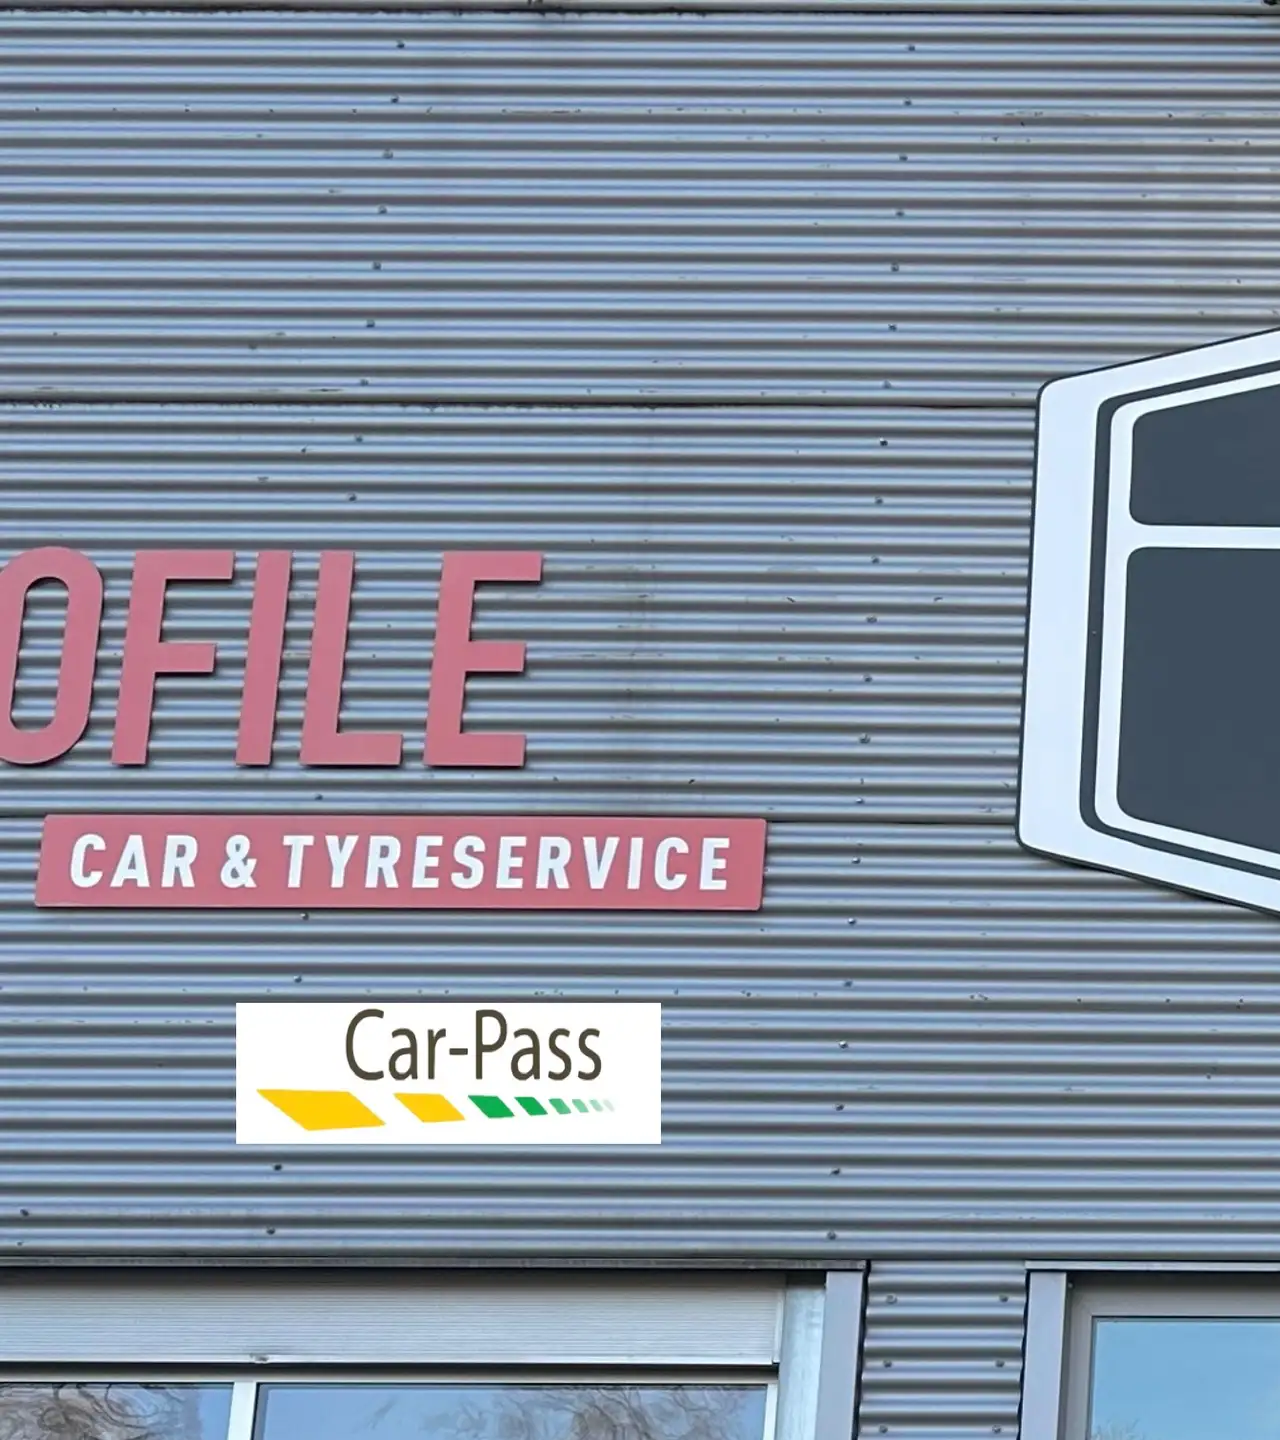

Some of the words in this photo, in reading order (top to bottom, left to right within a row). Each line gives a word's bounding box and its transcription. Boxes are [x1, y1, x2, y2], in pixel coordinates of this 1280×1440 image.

[0, 546, 544, 768] OFILE
[70, 833, 198, 889] CAR
[219, 834, 257, 889] &
[283, 834, 733, 891] TYRESERVICE
